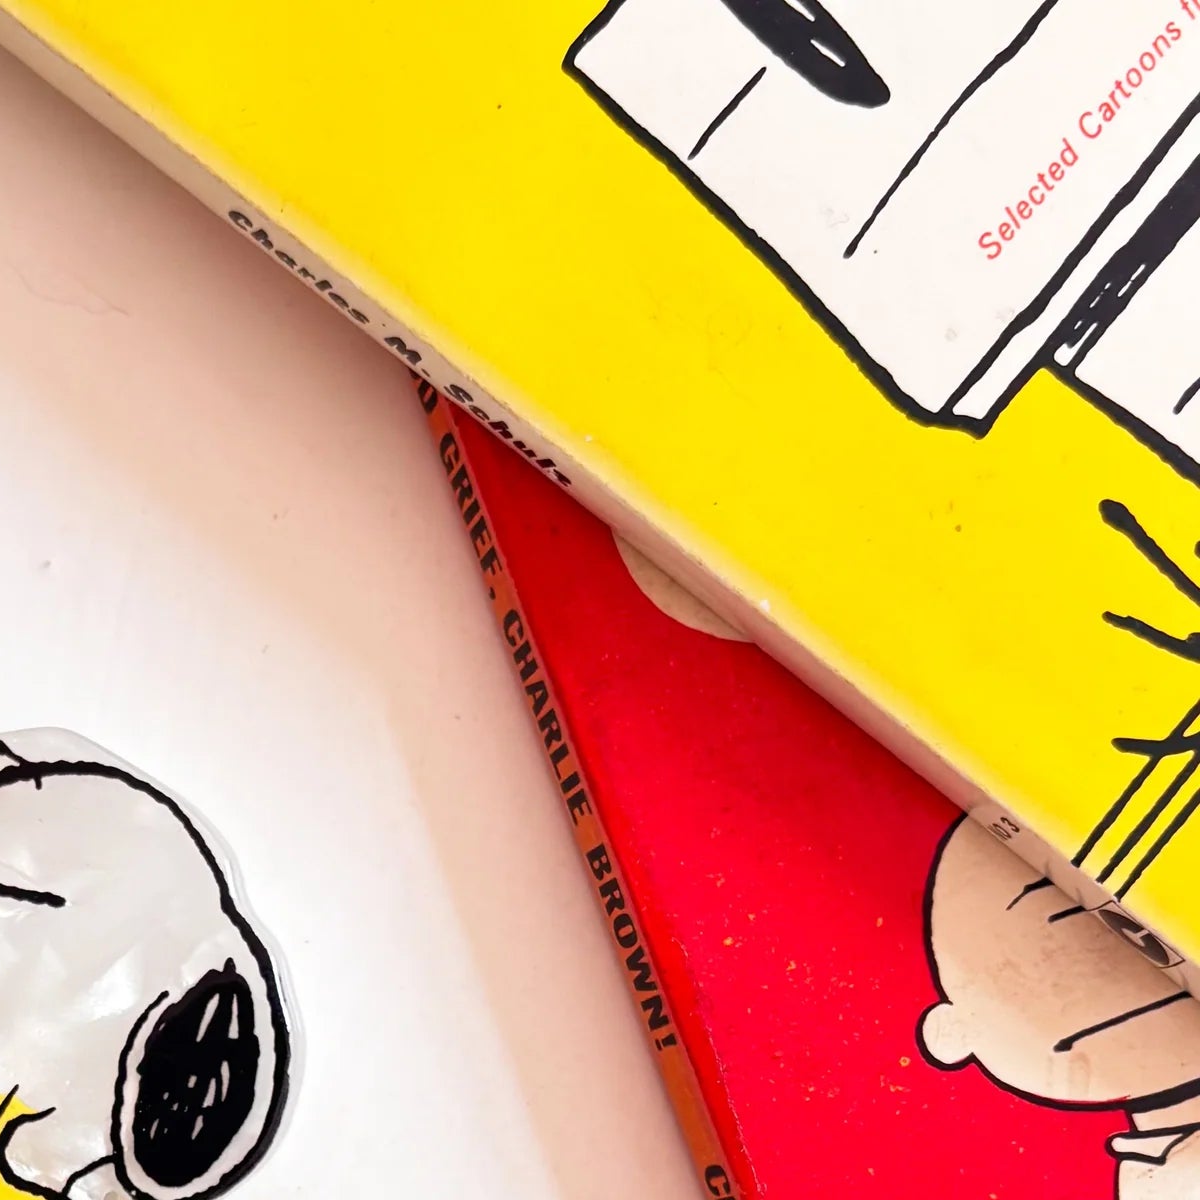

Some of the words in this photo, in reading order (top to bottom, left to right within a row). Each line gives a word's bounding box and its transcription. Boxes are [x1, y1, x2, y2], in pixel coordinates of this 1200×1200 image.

[977, 137, 1079, 260] Selected
[1078, 21, 1182, 139] Cartoons
[228, 210, 370, 325] Charles
[384, 336, 431, 378] M.
[443, 384, 572, 487] Schulz
[503, 608, 593, 827] CHARLIE
[586, 843, 678, 1052] BROWN!
